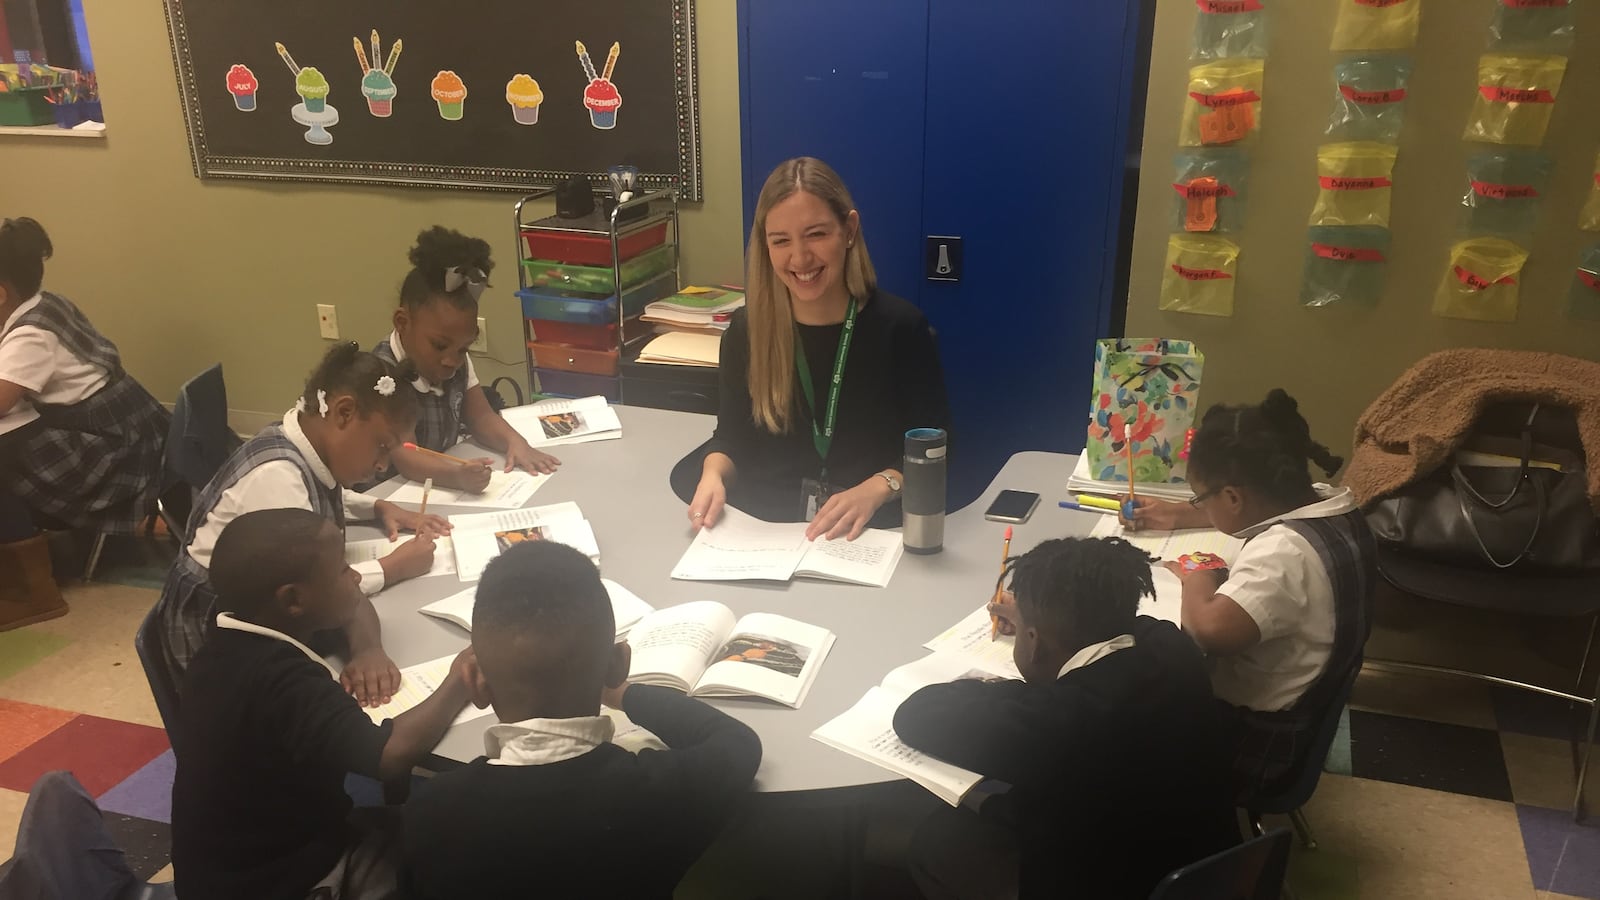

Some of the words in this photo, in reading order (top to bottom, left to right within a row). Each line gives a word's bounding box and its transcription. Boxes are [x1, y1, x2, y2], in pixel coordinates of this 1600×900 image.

[234, 83, 251, 91] JULY
[299, 84, 328, 93] AUGUST
[434, 89, 464, 98] OCTOBER
[586, 97, 619, 107] DECEMBER
